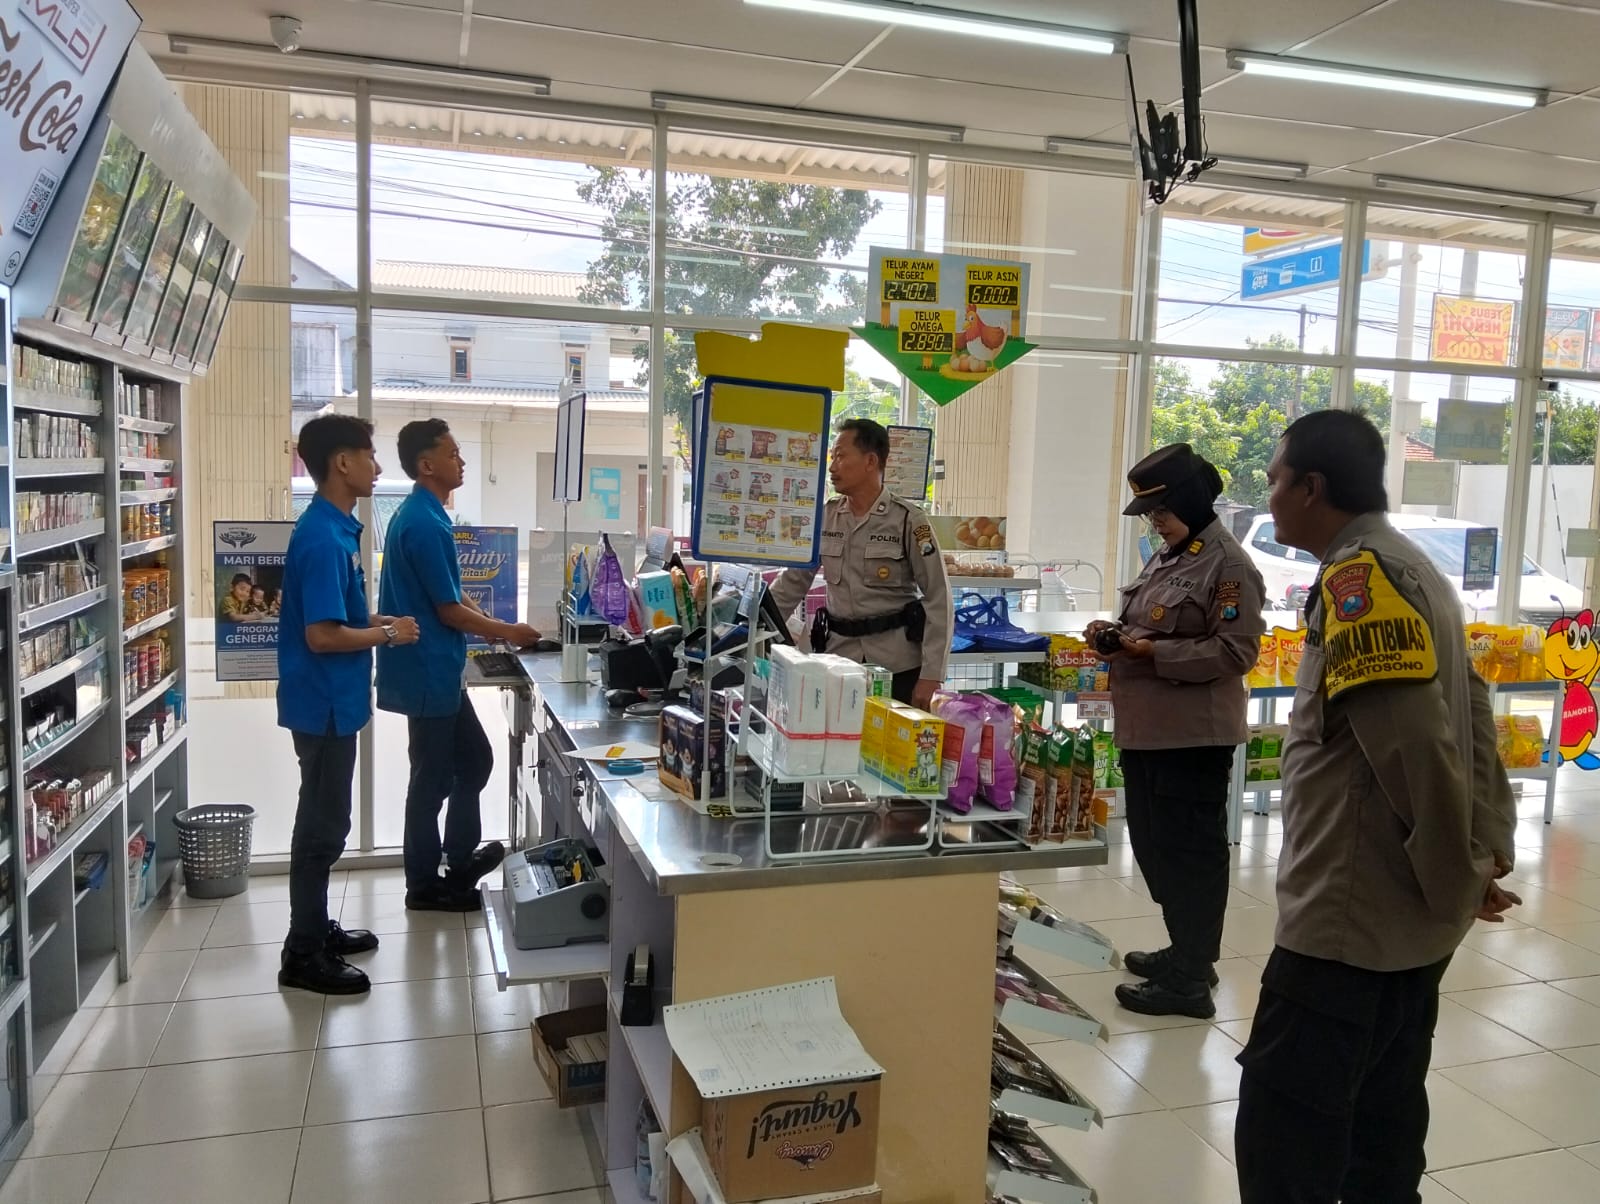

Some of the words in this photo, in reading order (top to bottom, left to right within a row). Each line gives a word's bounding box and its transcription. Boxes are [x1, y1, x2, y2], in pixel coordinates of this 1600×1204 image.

[19, 79, 84, 154] Cola
[885, 260, 909, 270] TELUR
[911, 262, 934, 272] AYAM
[894, 271, 925, 280] NEGERI
[968, 270, 993, 281] TELUR
[996, 272, 1019, 282] ASIN
[887, 281, 929, 300] 2.400
[971, 286, 1011, 304] 6.000
[914, 311, 940, 321] TELUR
[910, 321, 944, 332] OMEGA
[904, 333, 945, 351] 2.890
[870, 534, 900, 543] POLISI
[223, 555, 255, 565] MARI
[456, 549, 506, 570] ainty
[746, 1090, 862, 1159] Yogurt!
